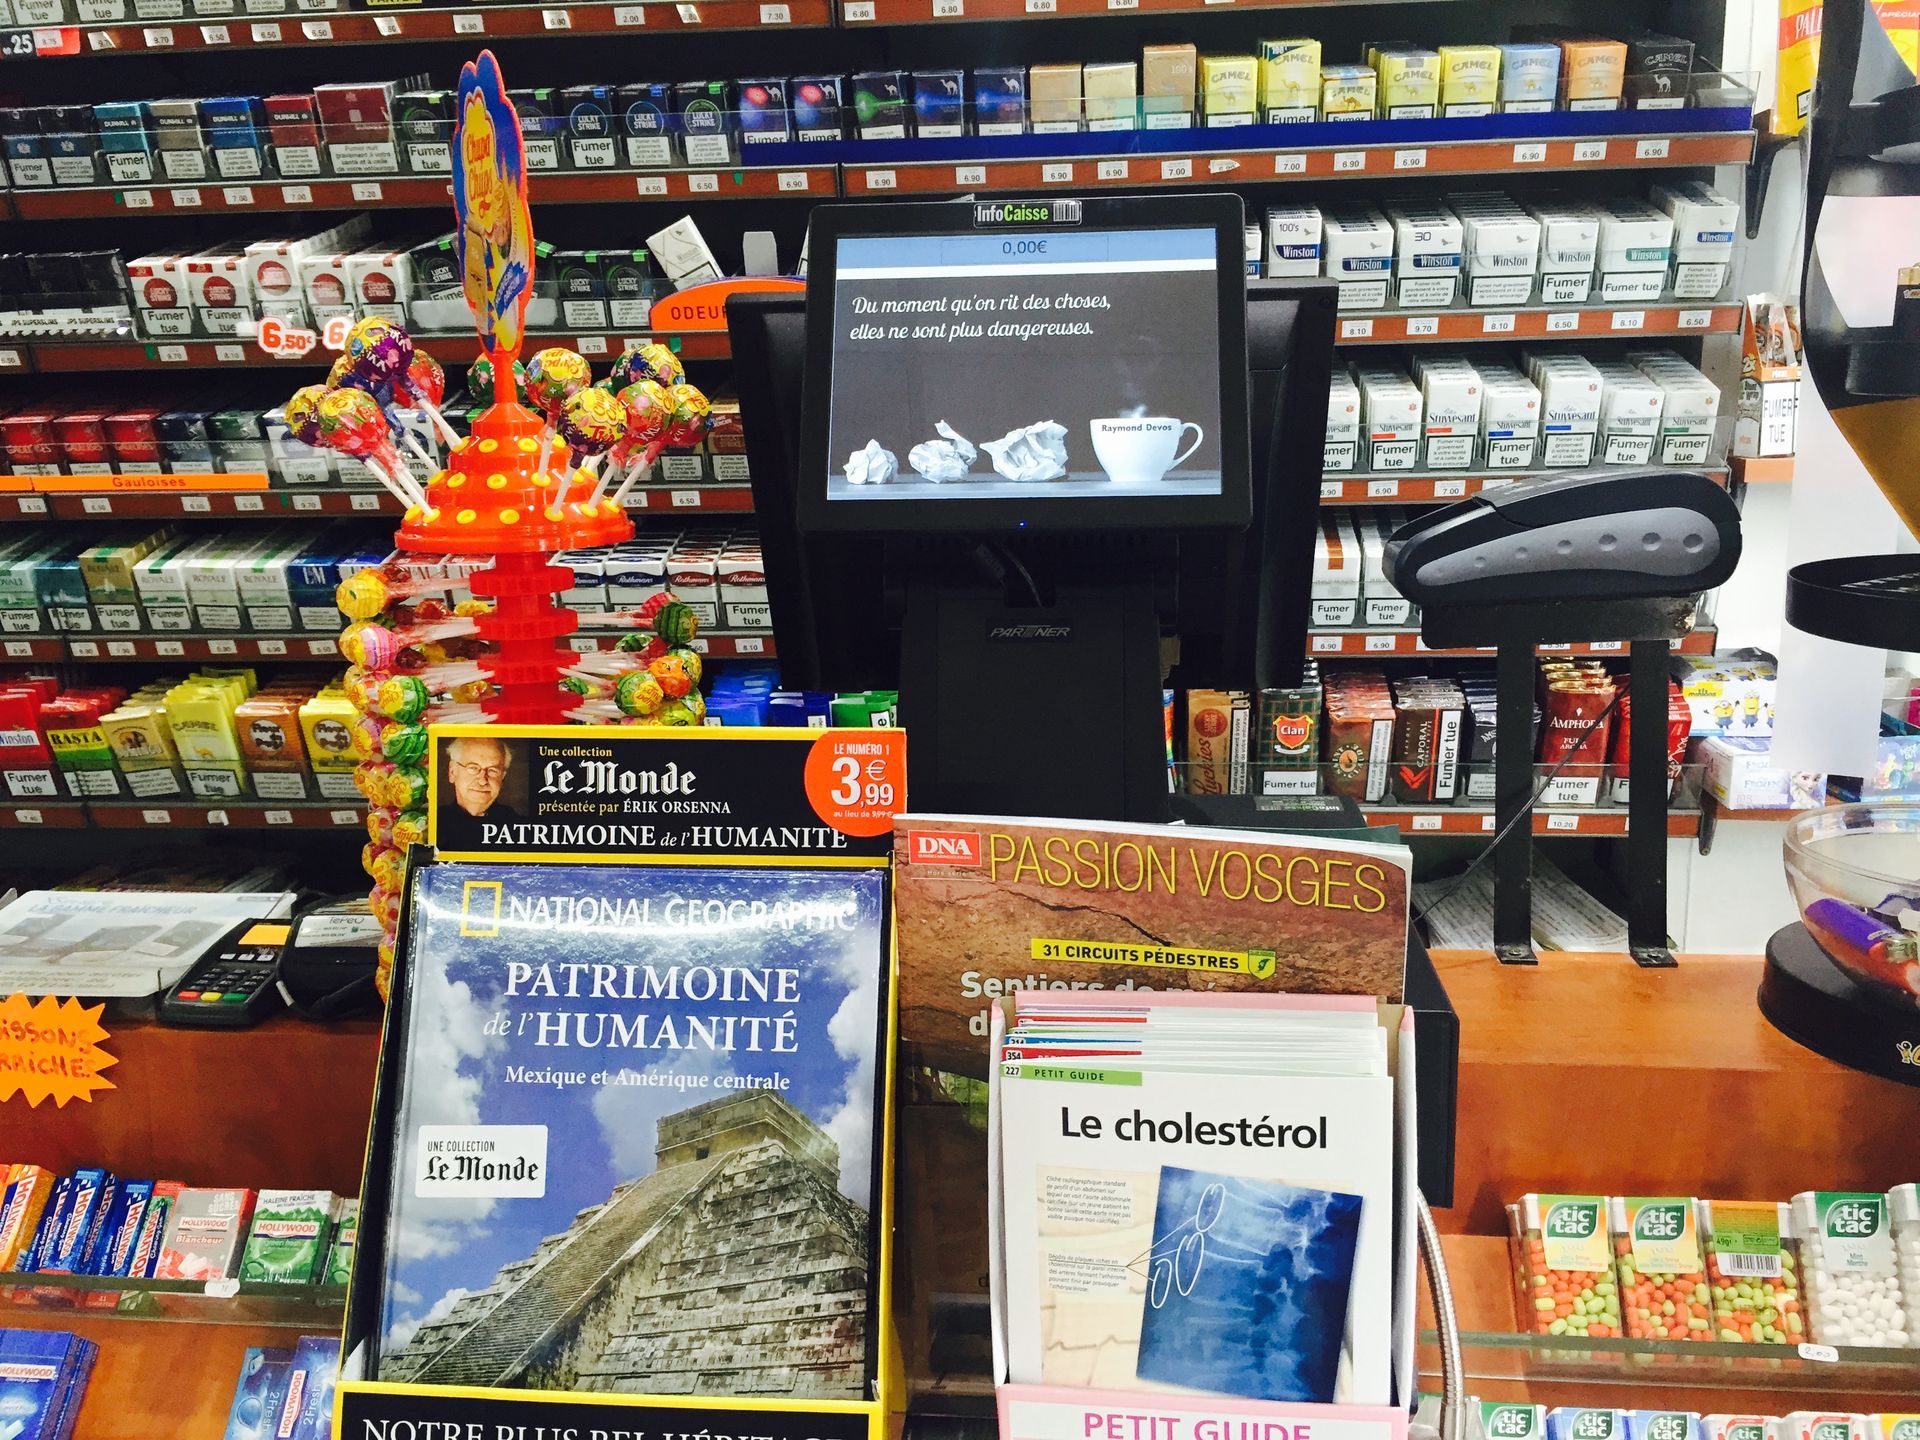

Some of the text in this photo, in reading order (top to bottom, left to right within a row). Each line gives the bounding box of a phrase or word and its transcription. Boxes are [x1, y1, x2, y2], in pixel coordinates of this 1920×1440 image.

[853, 10, 869, 18] 6.80
[941, 6, 958, 14] 6.80
[623, 15, 639, 23] 2.00
[768, 12, 784, 20] 7.30
[1451, 60, 1494, 73] CAMEL
[1393, 70, 1434, 82] CAMEL
[573, 140, 611, 151] Fumer
[109, 155, 145, 166] Fumer
[585, 155, 604, 165] tue
[1343, 160, 1359, 168] 6.90
[1402, 158, 1420, 166] 6.90
[121, 169, 140, 179] tue
[1168, 168, 1185, 176] 7.00
[977, 204, 1048, 222] InfoCaisse
[1414, 231, 1431, 241] 30
[1002, 240, 1047, 255] 0,00€
[1283, 245, 1316, 258] Winston
[1420, 255, 1453, 267] Winston
[1492, 254, 1528, 267] Winston
[1558, 250, 1591, 262] Winston
[1350, 259, 1382, 270] Winston
[1546, 278, 1587, 288] Fumer
[1605, 282, 1659, 291] Fumer tue
[1554, 289, 1574, 299] tue
[852, 293, 1111, 318] Du moment qu'on rit des choses,
[1491, 322, 1508, 330] 8.10
[1554, 320, 1572, 328] 6.50
[1686, 318, 1704, 326] 6.50
[850, 321, 1094, 342] elles ne sont plus dangereuses.
[1764, 398, 1792, 417] FUMER
[1429, 413, 1475, 423] Stuyvesant
[1548, 410, 1596, 421] Stuyvesant
[1101, 423, 1172, 433] Raymond Devos
[1769, 424, 1786, 443] TUE
[1492, 443, 1531, 452] Fumer
[1609, 438, 1649, 450] Fumer
[1666, 439, 1706, 449] Fumer
[1375, 445, 1414, 455] Fumer
[1384, 457, 1403, 467] tue
[1500, 455, 1519, 465] tue
[1617, 452, 1636, 462] tue
[1674, 452, 1694, 461] tue
[112, 477, 186, 488] Gauloises
[618, 575, 653, 583] Rothmans
[675, 575, 709, 583] Rothmans
[1317, 604, 1349, 612] Fumer
[743, 616, 761, 625] tue
[1280, 726, 1304, 735] Clan
[50, 731, 103, 746] RASTA
[1417, 721, 1428, 767] CAPORAL
[539, 746, 613, 757] Une collection
[834, 744, 845, 755] LE
[847, 743, 882, 755] NUMÉRO
[8, 773, 47, 782] Fumer
[538, 760, 697, 795] Le Monde
[1264, 780, 1297, 788] Fumer
[1558, 792, 1578, 801] tue
[538, 798, 731, 815] présentée par ÉRIK ORSENNA
[843, 810, 859, 818] lieu
[860, 810, 870, 818] de
[481, 823, 656, 846] PATRIMOINE
[660, 833, 677, 846] de
[918, 837, 972, 855] DNA
[990, 834, 1386, 914] PASSION VOSGES
[509, 896, 857, 932] NATIONAL GEOGRAPHIC
[1043, 944, 1060, 957] 31
[1066, 945, 1139, 962] CIRCUITS
[1144, 947, 1239, 970] PÉDESTRES
[504, 962, 800, 1003] PATRIMOINE
[483, 1012, 511, 1037] de
[505, 1066, 790, 1091] Mexique et Amérique centrale
[1005, 1066, 1104, 1081] 227 PETIT GUIDE
[1061, 1107, 1327, 1149] Le cholestérol
[427, 1141, 495, 1152] UNE COLLECTION
[423, 1155, 539, 1181] Le Monde
[263, 1195, 288, 1204] HALEINE
[1562, 1206, 1589, 1221] tic
[1650, 1208, 1677, 1223] tic
[1842, 1204, 1872, 1220] tic
[181, 1218, 227, 1227] HOLLYWOOD
[258, 1223, 316, 1233] HOLLYWOOD
[1554, 1220, 1589, 1233] tac
[1833, 1220, 1872, 1233] tac
[1643, 1222, 1677, 1236] tac
[175, 1234, 223, 1244] Blancheur
[281, 1373, 302, 1434] HOLLYWOOD
[303, 1384, 321, 1425] 2Fresh
[1502, 1410, 1526, 1424] tic
[1584, 1413, 1607, 1427] tic
[1660, 1415, 1683, 1429] tic
[363, 1419, 484, 1440] NOTRE
[1084, 1412, 1181, 1440] PETIT
[1497, 1422, 1526, 1435] tac
[1578, 1424, 1607, 1438] tac
